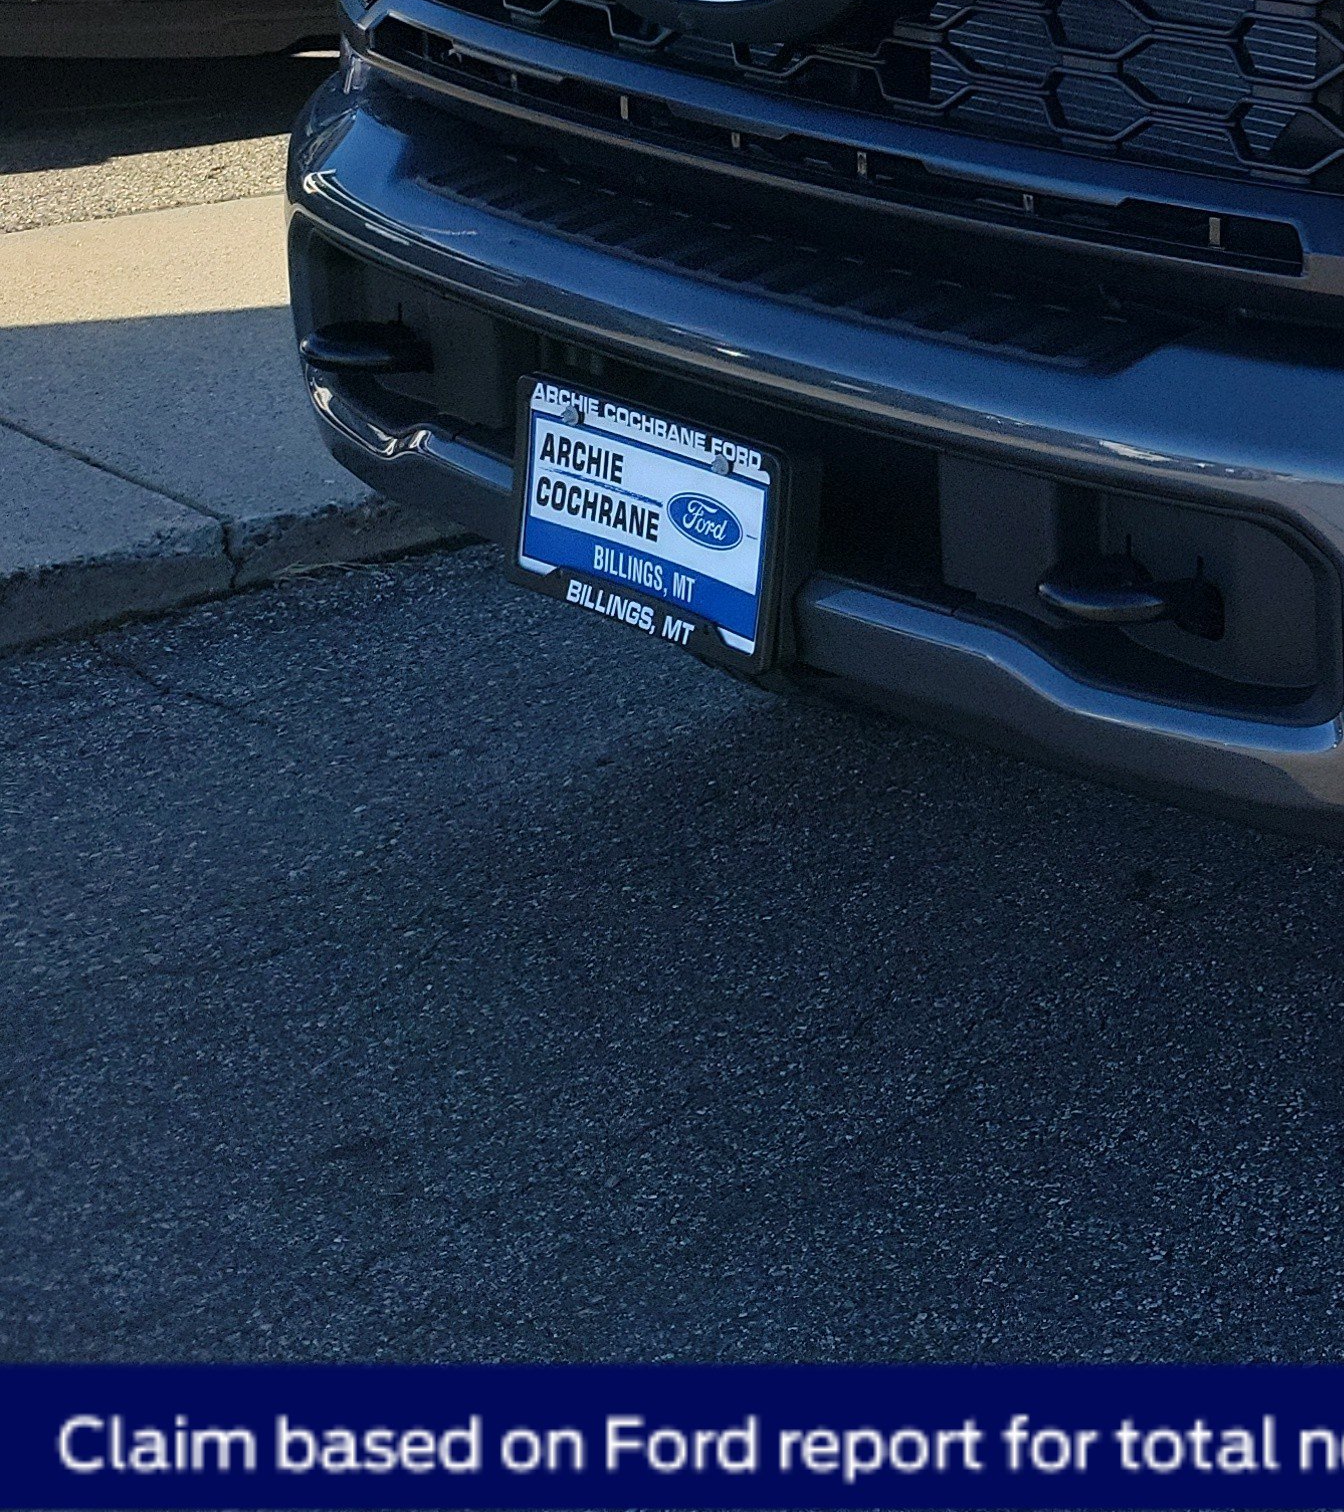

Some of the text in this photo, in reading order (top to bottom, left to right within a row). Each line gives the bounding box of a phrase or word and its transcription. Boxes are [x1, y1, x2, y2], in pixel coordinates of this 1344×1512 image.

[533, 382, 763, 472] ARCHIE COCHRANE FORD
[539, 432, 625, 485] ARCHIE
[535, 475, 661, 544] COCHRANE
[681, 498, 728, 542] Ford
[593, 544, 696, 603] BILLINGS, MT
[565, 579, 695, 645] BILLINGS, MT
